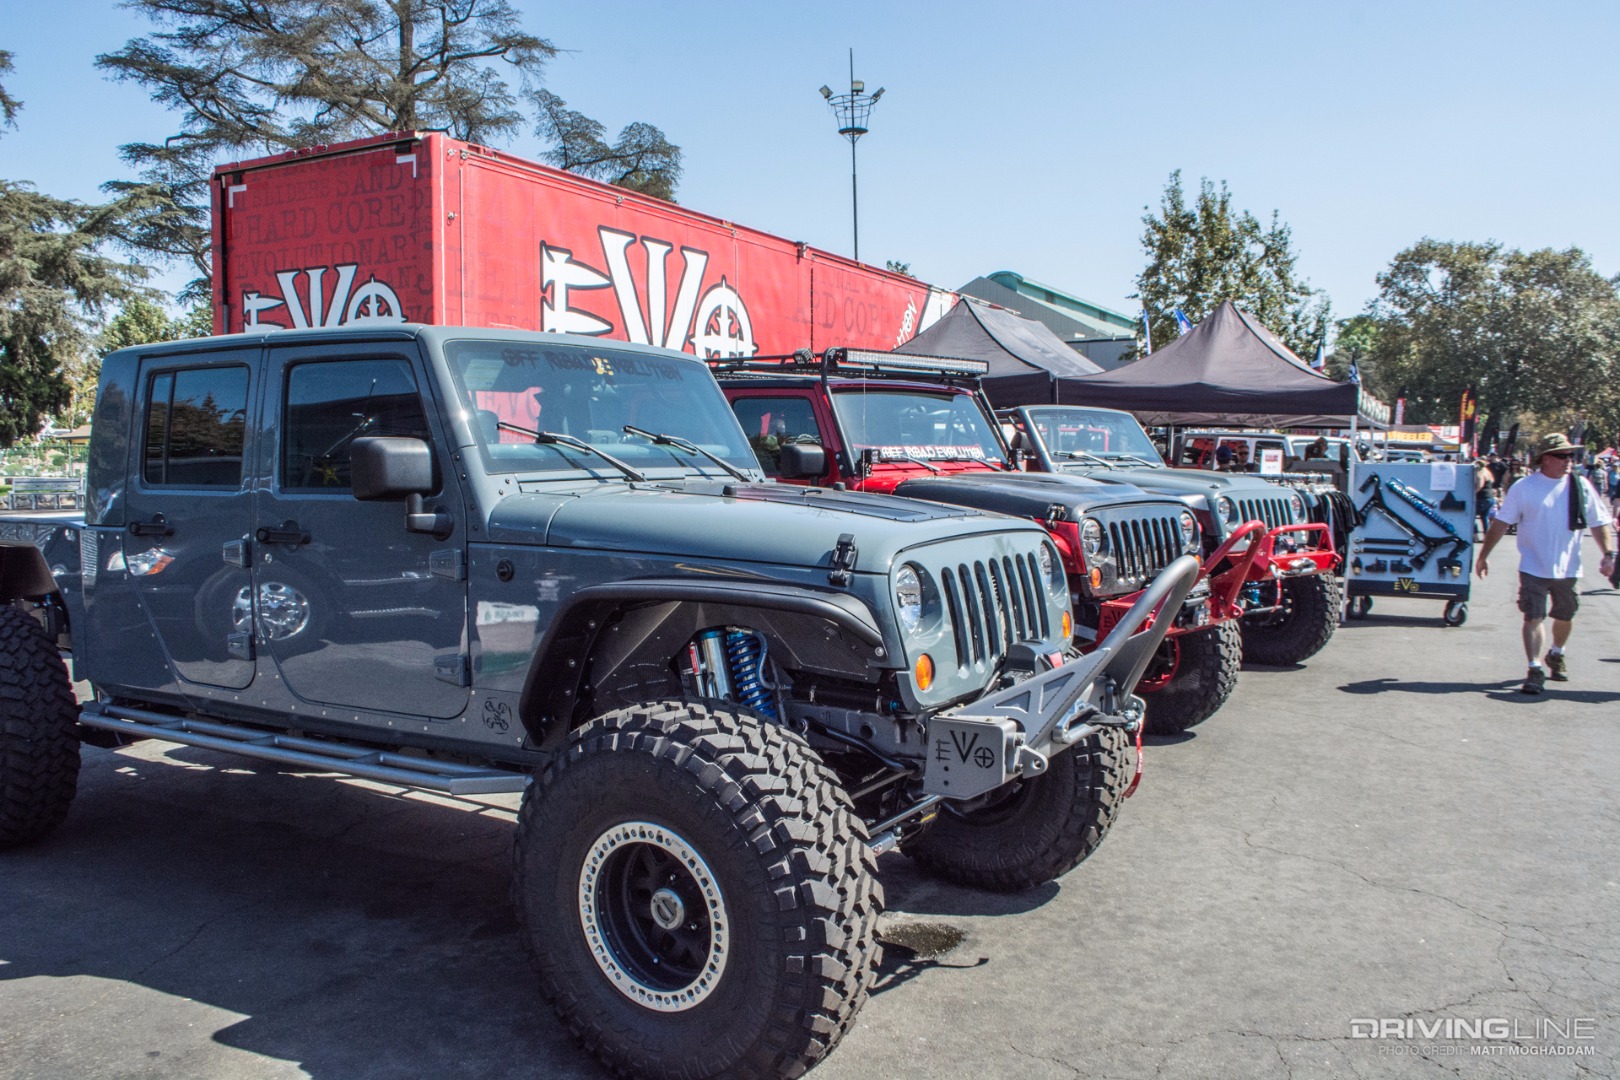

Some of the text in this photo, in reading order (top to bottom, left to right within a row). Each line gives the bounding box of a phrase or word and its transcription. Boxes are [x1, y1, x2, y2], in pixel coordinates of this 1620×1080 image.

[245, 194, 406, 245] HARD CORE
[935, 729, 995, 769] EVO
